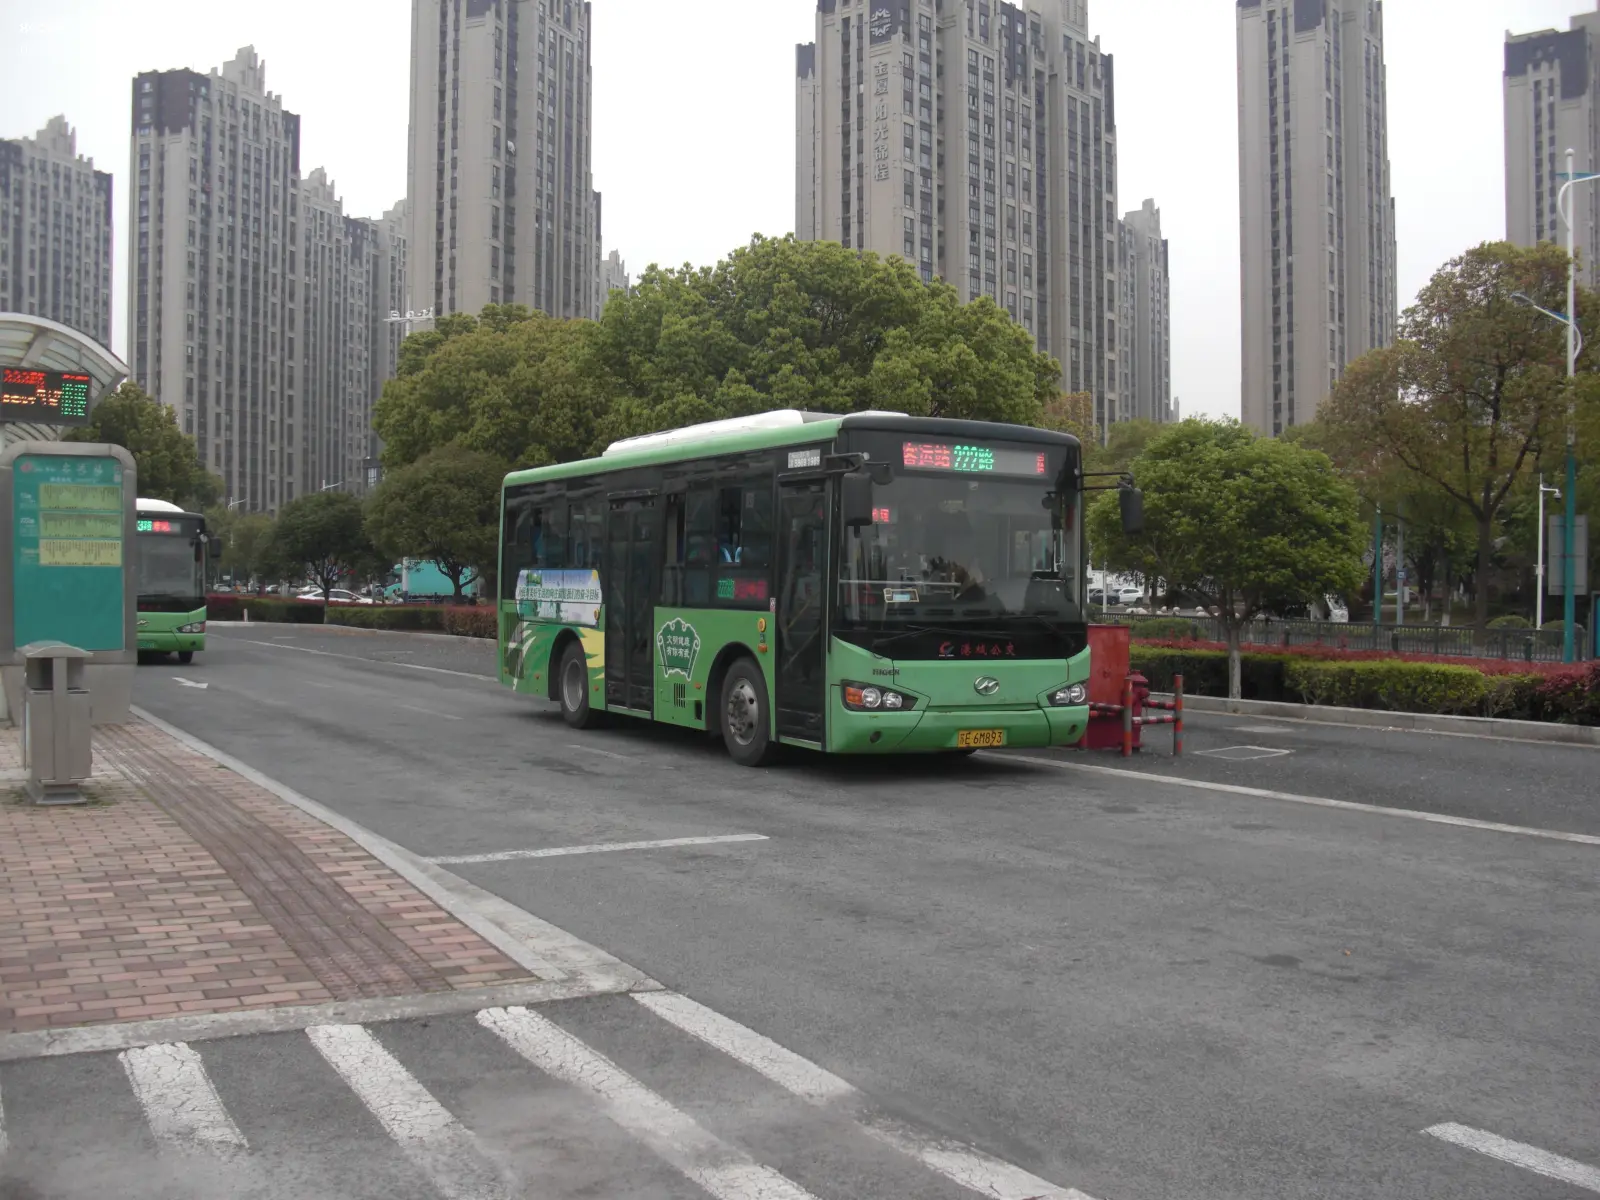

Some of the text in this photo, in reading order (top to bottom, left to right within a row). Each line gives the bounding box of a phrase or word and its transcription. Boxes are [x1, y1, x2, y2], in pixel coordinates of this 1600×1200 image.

[954, 445, 994, 472] 777路
[666, 634, 690, 647] 文明健康
[960, 642, 1016, 657] 港城公交
